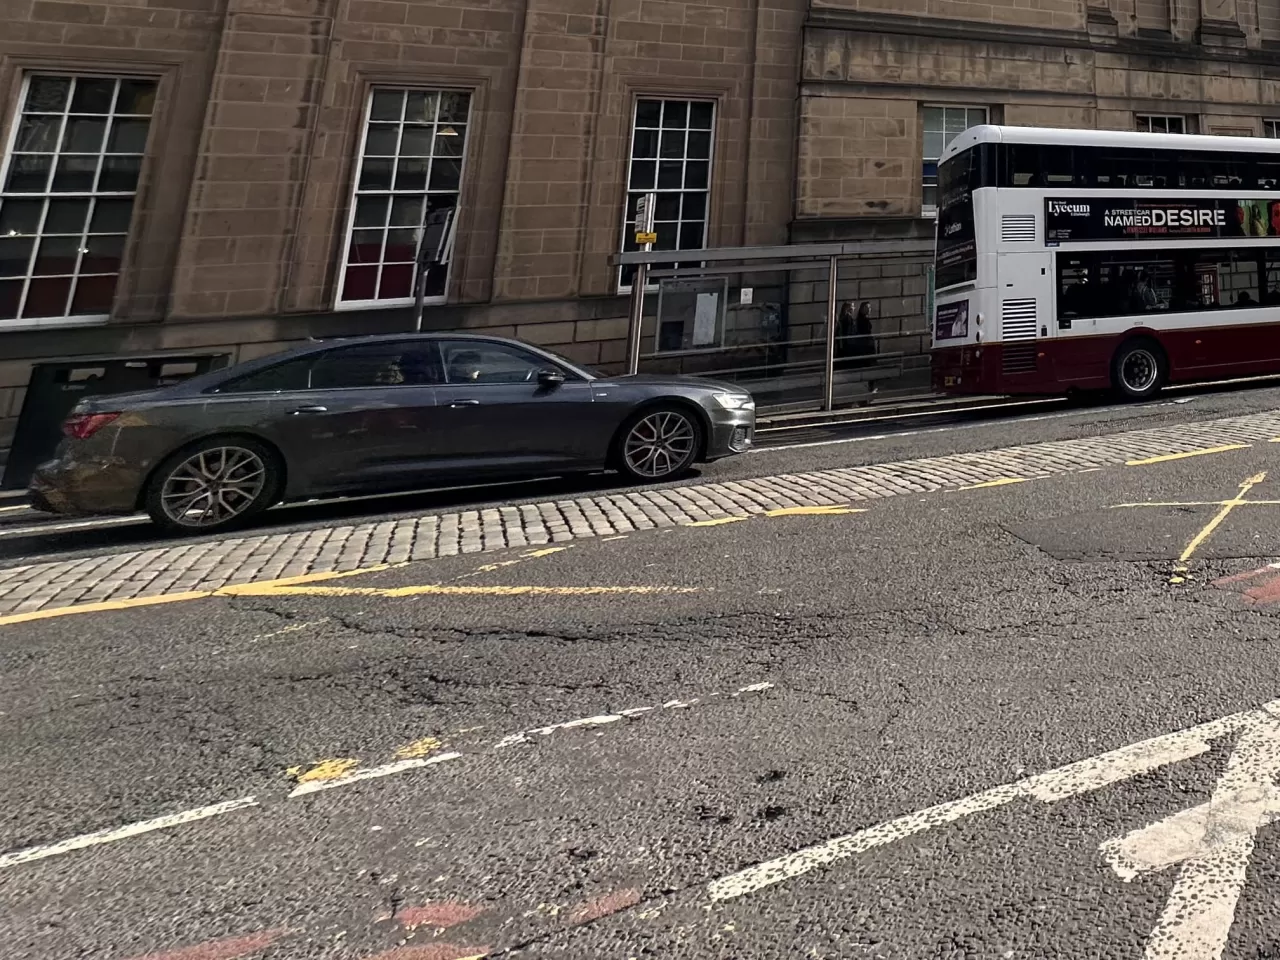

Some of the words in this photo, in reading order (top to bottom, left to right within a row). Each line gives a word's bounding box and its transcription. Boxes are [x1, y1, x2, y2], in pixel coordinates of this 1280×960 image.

[1048, 201, 1090, 216] Lyceum
[1104, 215, 1151, 227] NAMED
[1152, 209, 1226, 226] DESIRE
